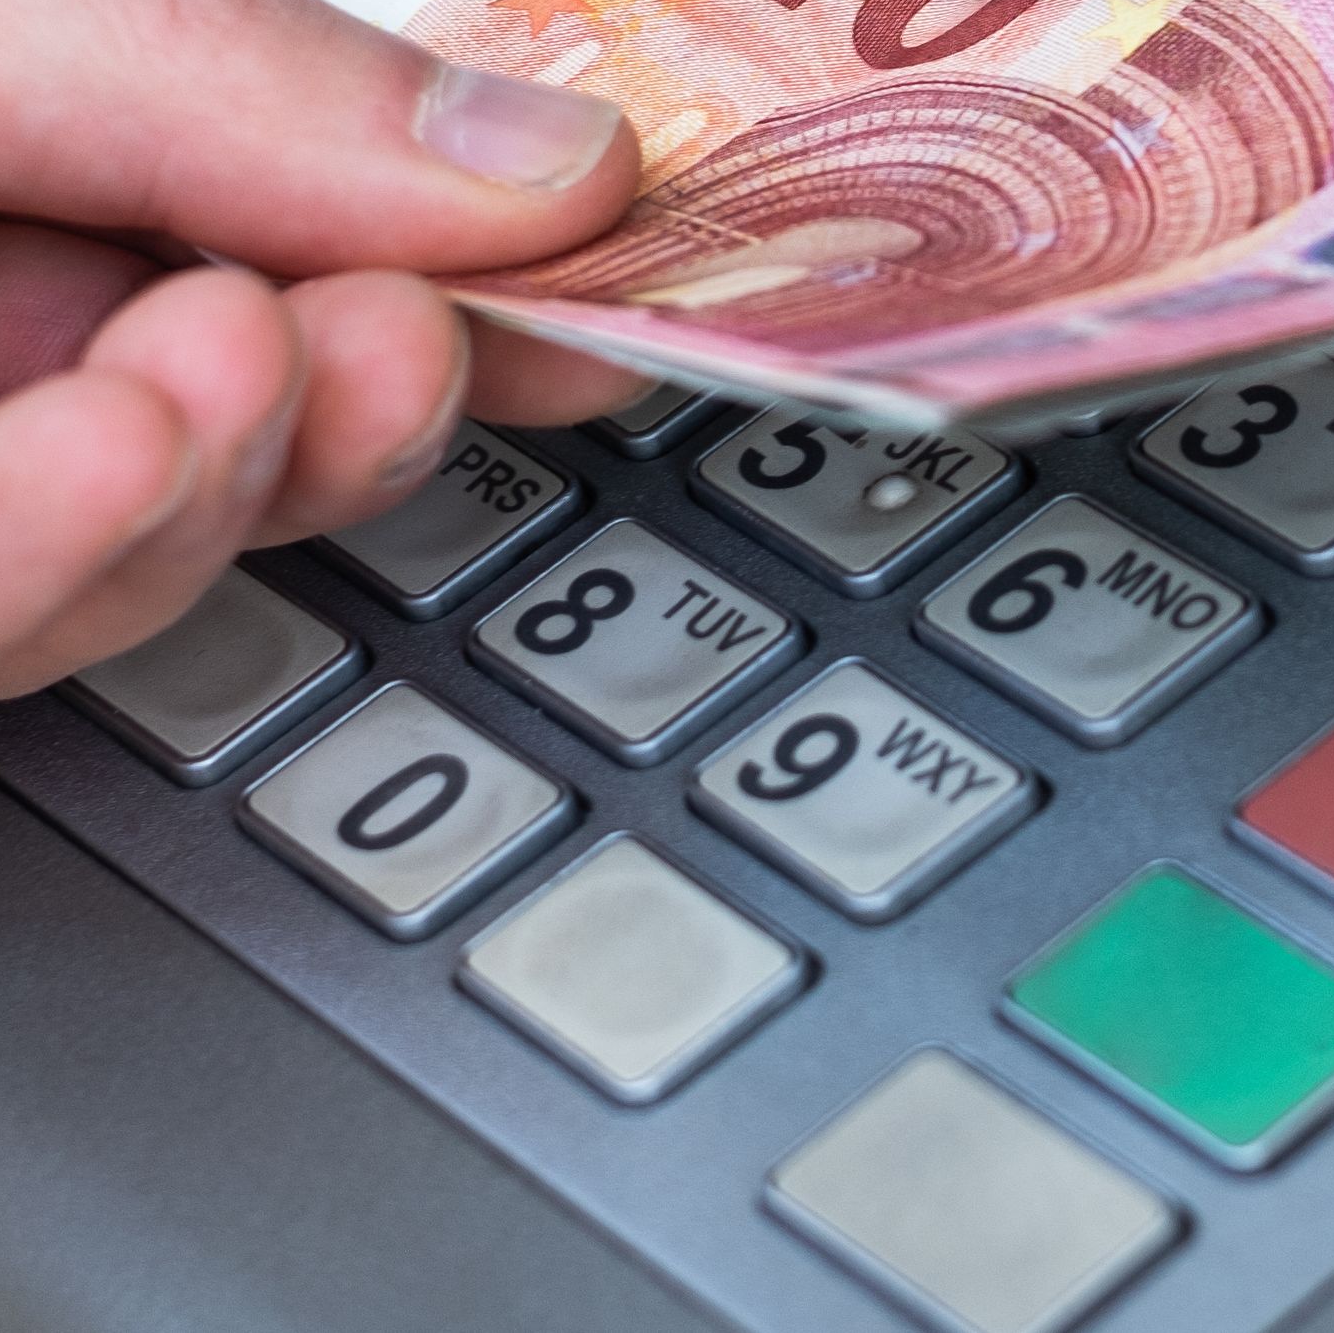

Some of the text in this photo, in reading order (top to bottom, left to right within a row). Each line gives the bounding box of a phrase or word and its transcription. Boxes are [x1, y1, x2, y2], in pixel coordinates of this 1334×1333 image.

[738, 411, 975, 494] 5 JKL
[1180, 384, 1299, 469] 3
[439, 443, 541, 513] PRS
[514, 568, 768, 656] 8 TUV
[967, 548, 1221, 635] 6 MNO
[337, 753, 469, 852] 0
[737, 712, 999, 806] 9 WXY
